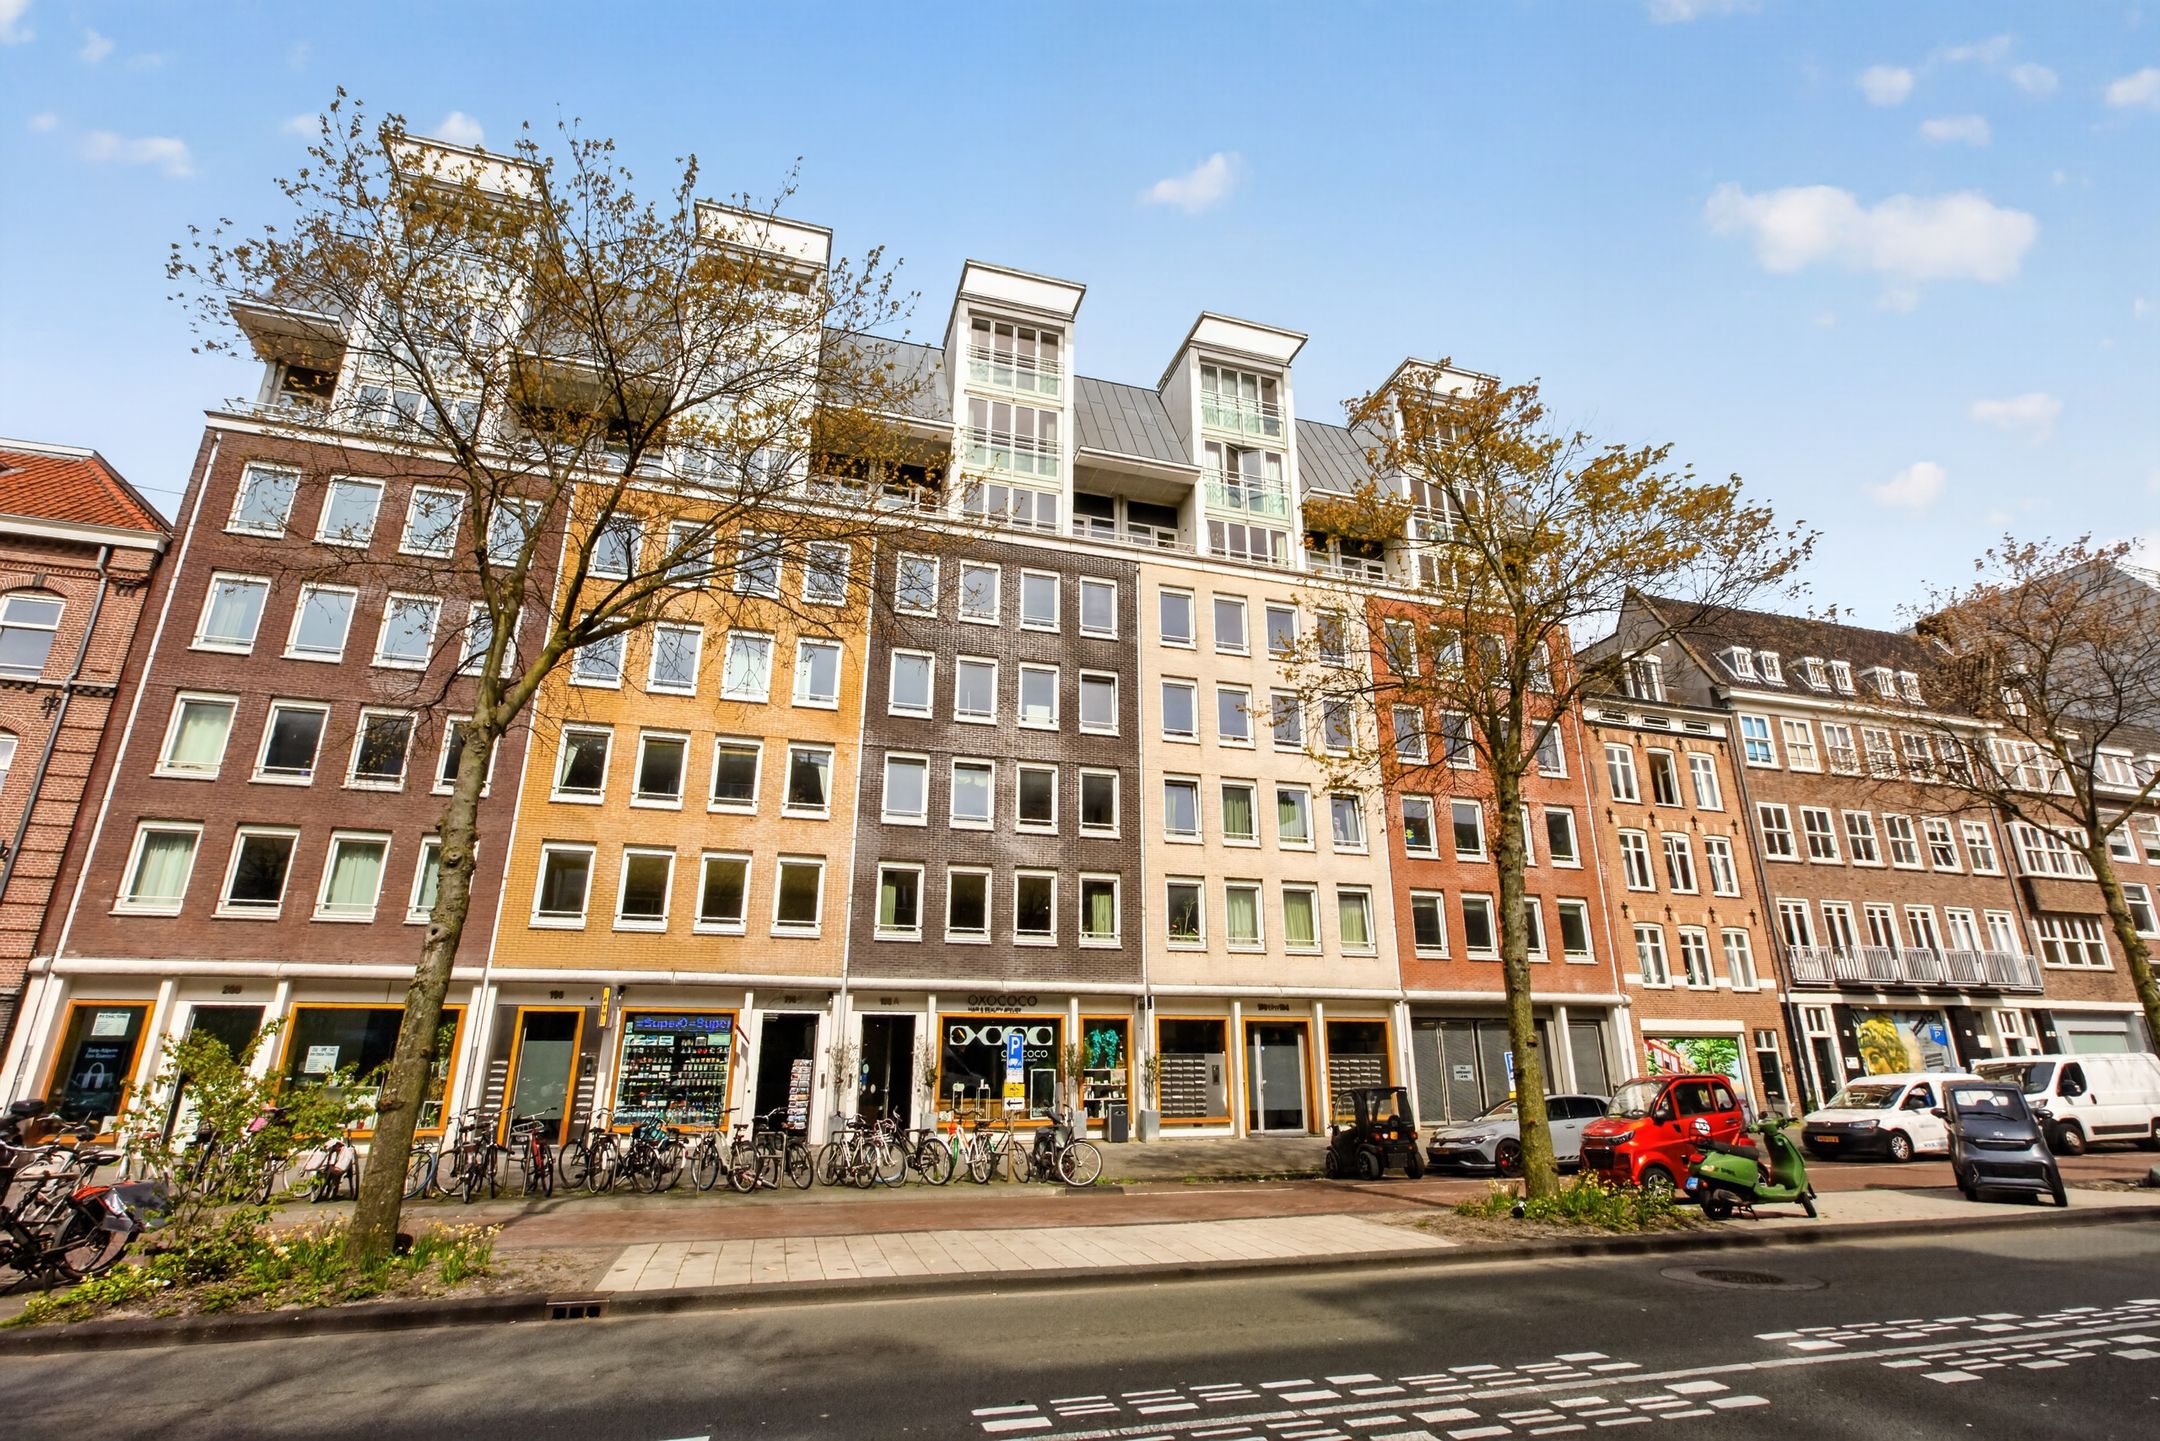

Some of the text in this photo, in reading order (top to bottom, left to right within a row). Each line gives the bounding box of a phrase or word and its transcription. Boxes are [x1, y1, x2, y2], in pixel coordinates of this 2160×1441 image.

[967, 994, 1037, 1006] OXOCOCO
[1011, 1037, 1020, 1055] P
[1001, 1050, 1048, 1058] OCOCO
